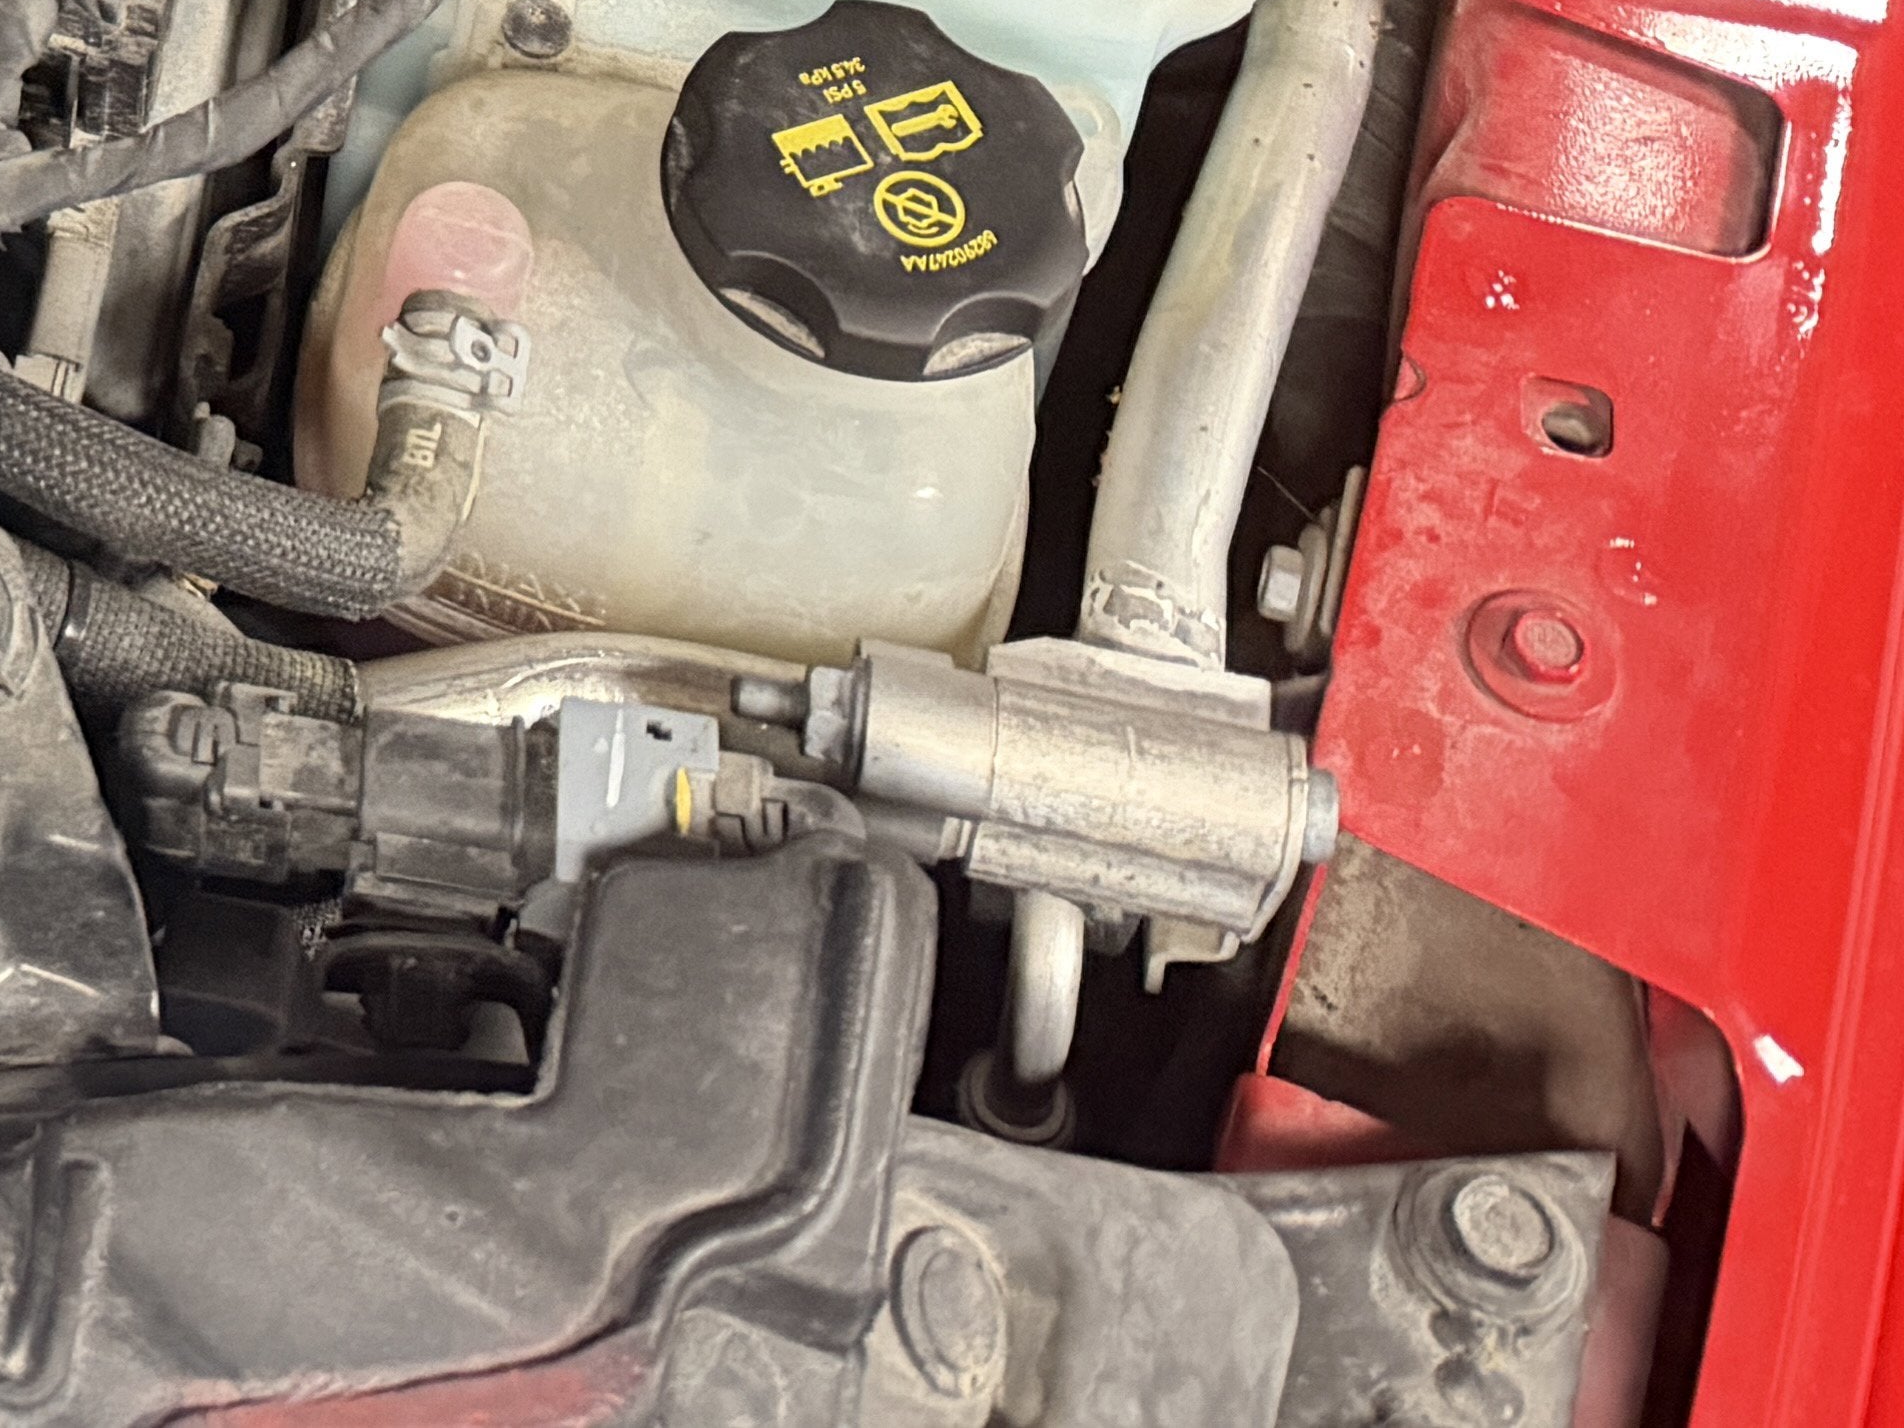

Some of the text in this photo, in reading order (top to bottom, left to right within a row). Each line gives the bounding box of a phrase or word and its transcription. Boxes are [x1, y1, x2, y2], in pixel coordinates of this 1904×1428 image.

[798, 56, 866, 86] 34.5 kPa
[822, 79, 867, 104] 5 PSI
